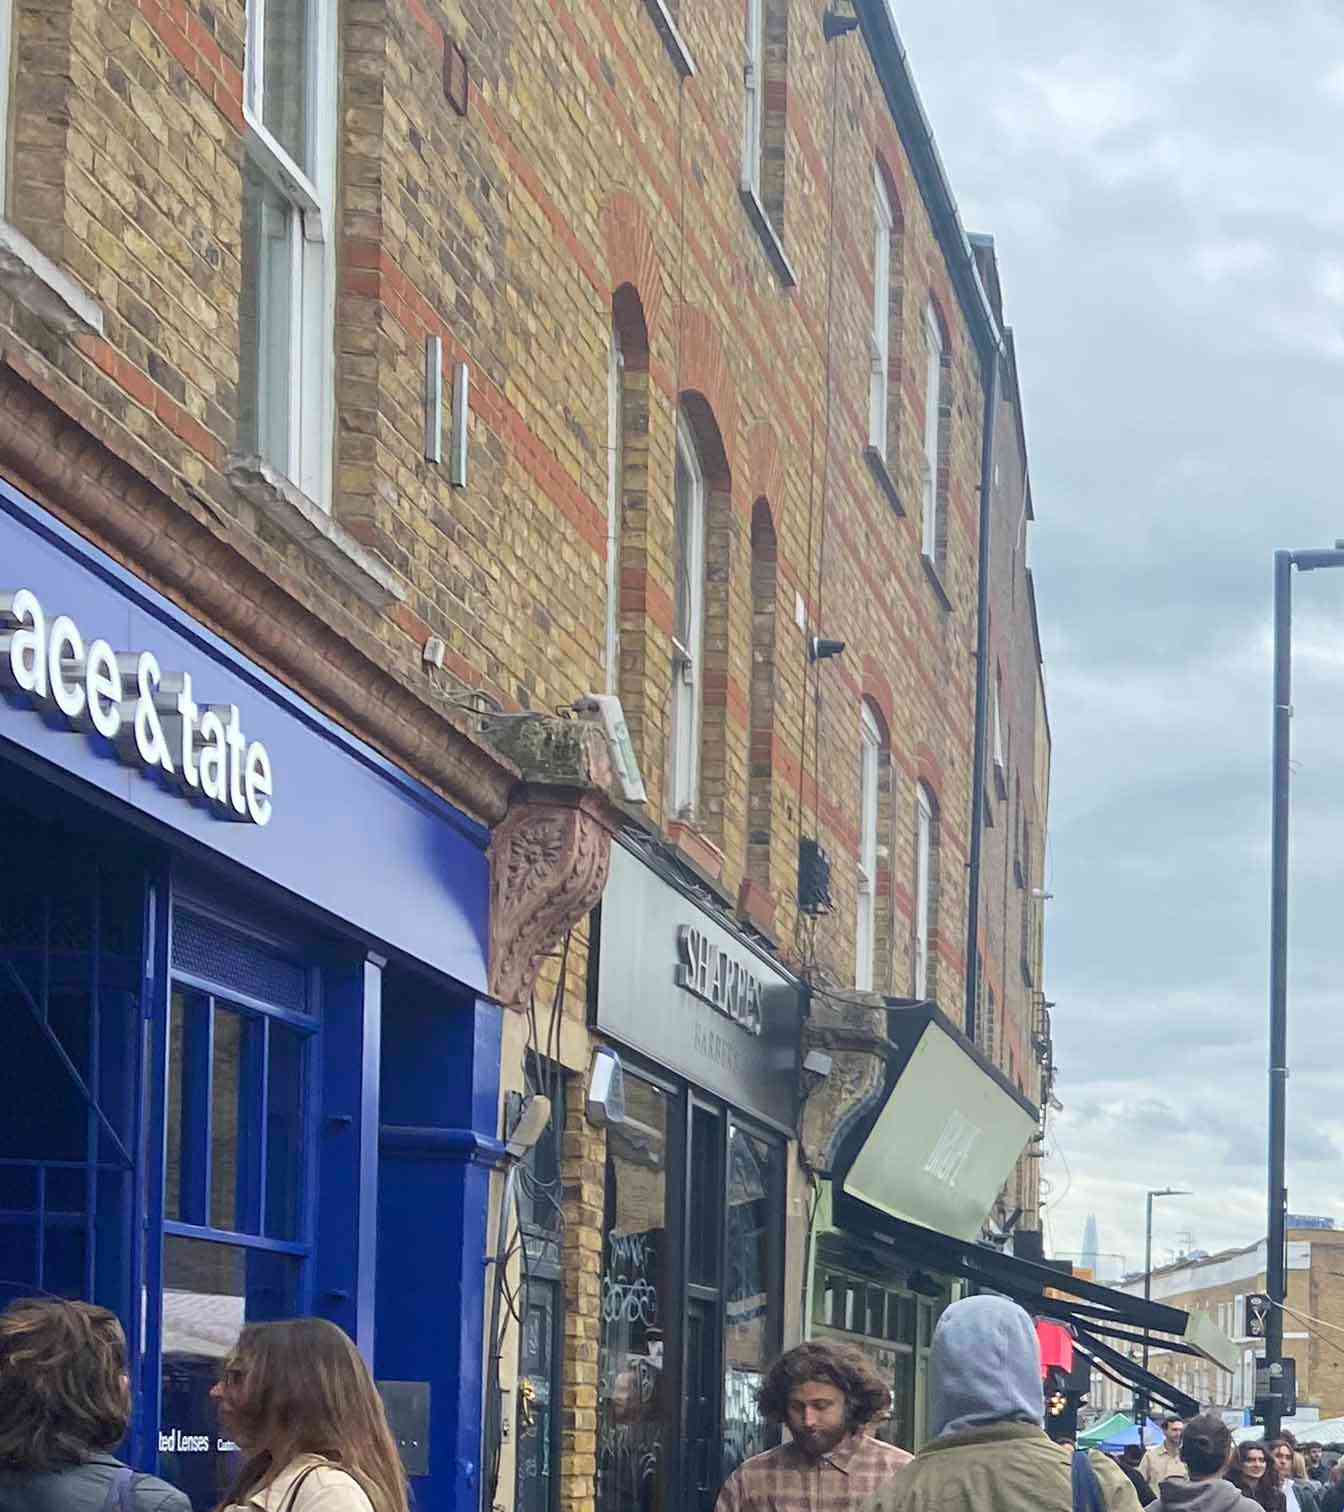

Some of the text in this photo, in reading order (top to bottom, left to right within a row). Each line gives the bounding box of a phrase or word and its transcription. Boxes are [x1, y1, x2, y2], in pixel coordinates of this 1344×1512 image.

[9, 588, 273, 826] ace & tate
[177, 1430, 209, 1453] Lenses
